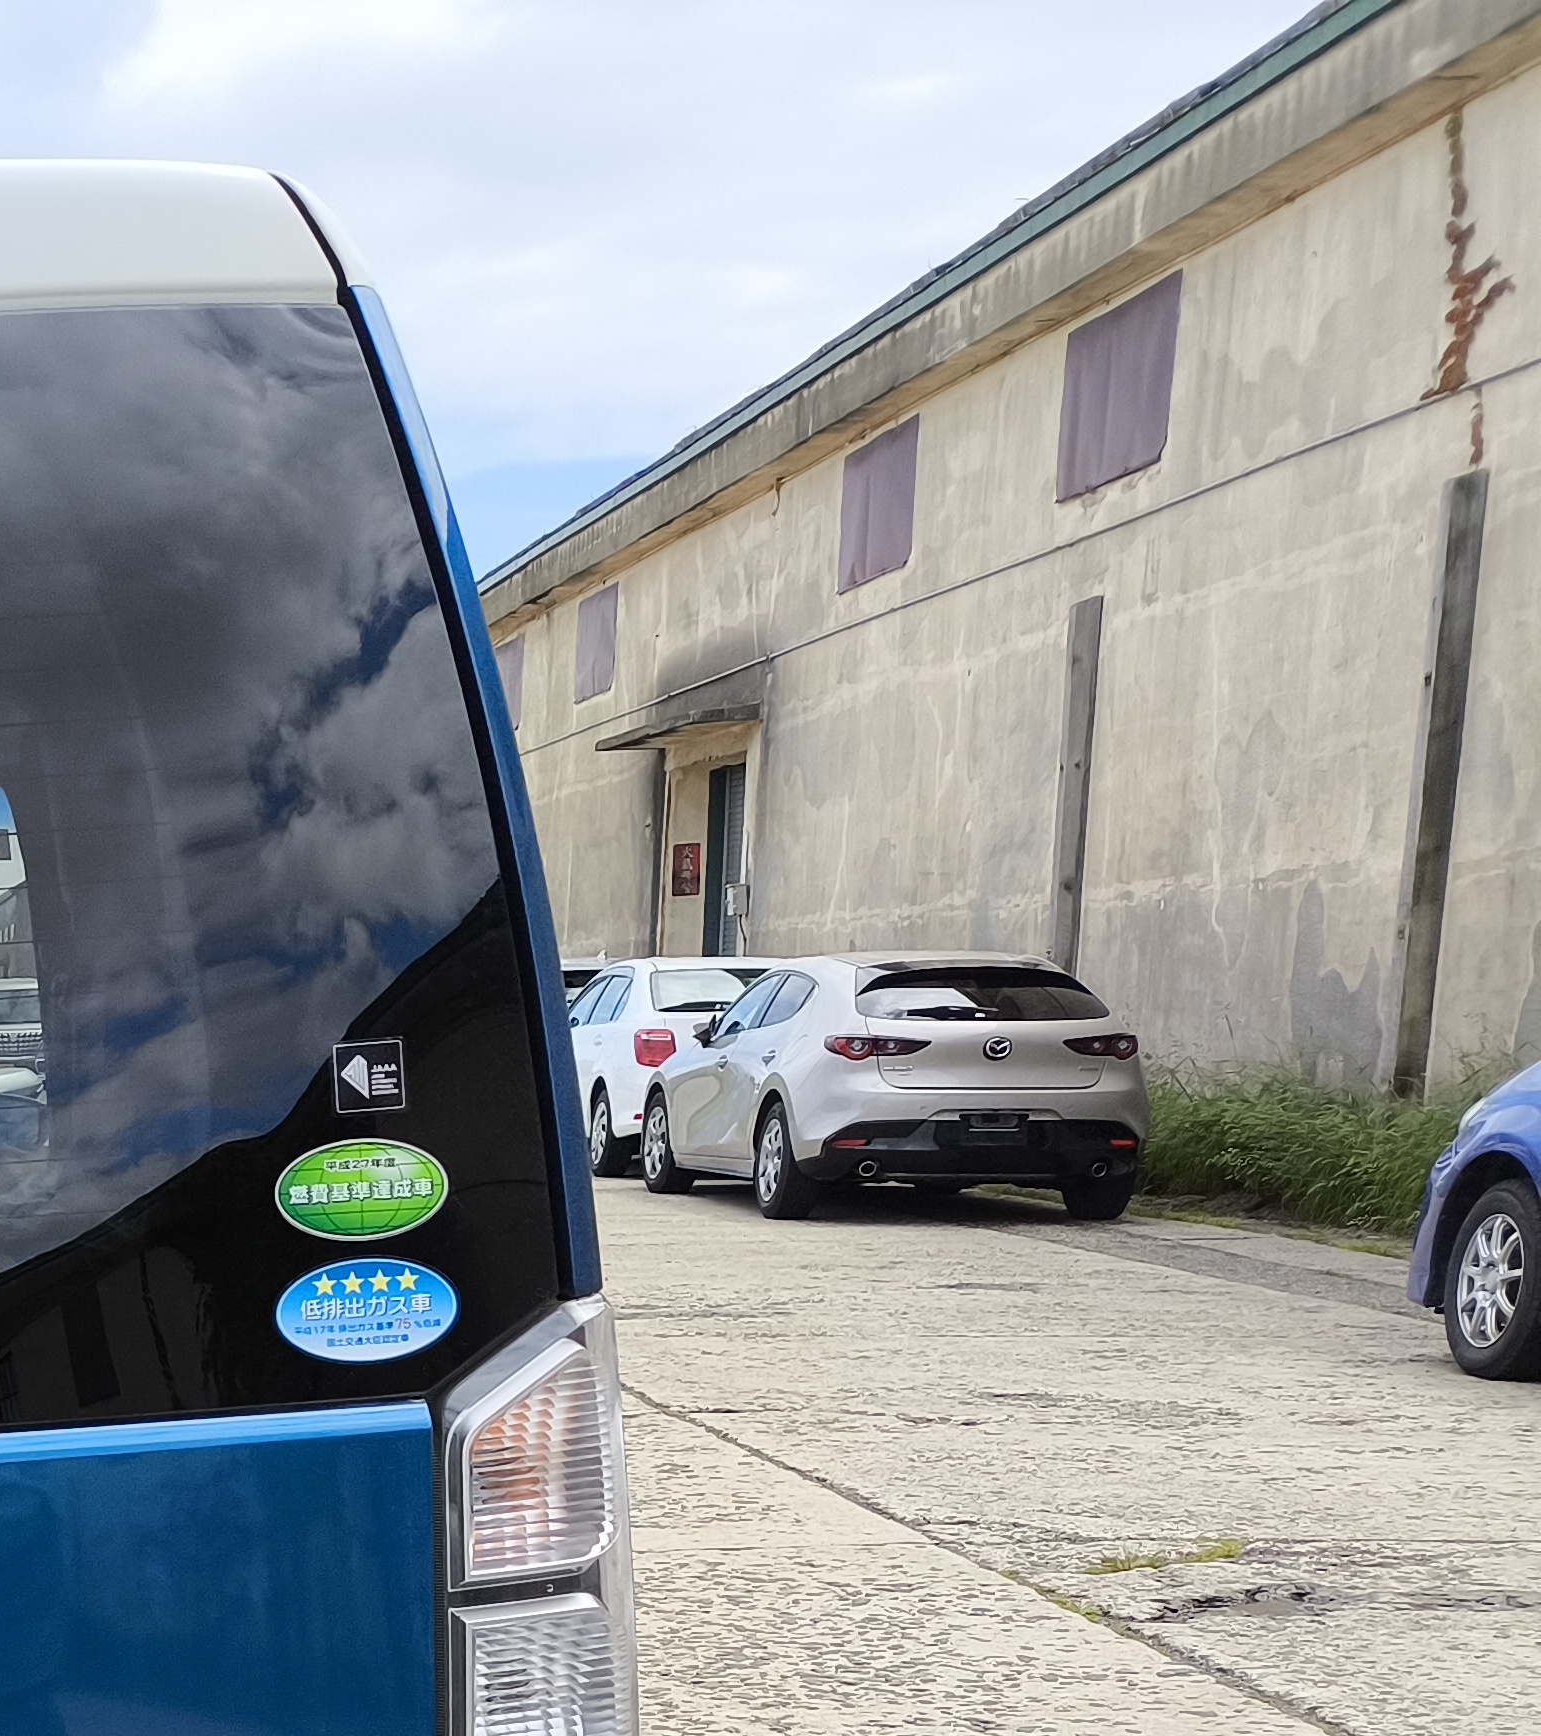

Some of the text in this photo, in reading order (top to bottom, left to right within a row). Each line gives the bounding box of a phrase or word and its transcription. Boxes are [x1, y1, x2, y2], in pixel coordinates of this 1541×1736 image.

[288, 1178, 434, 1205] 燃費基準達成車
[301, 1293, 433, 1320] 低排出ガス車
